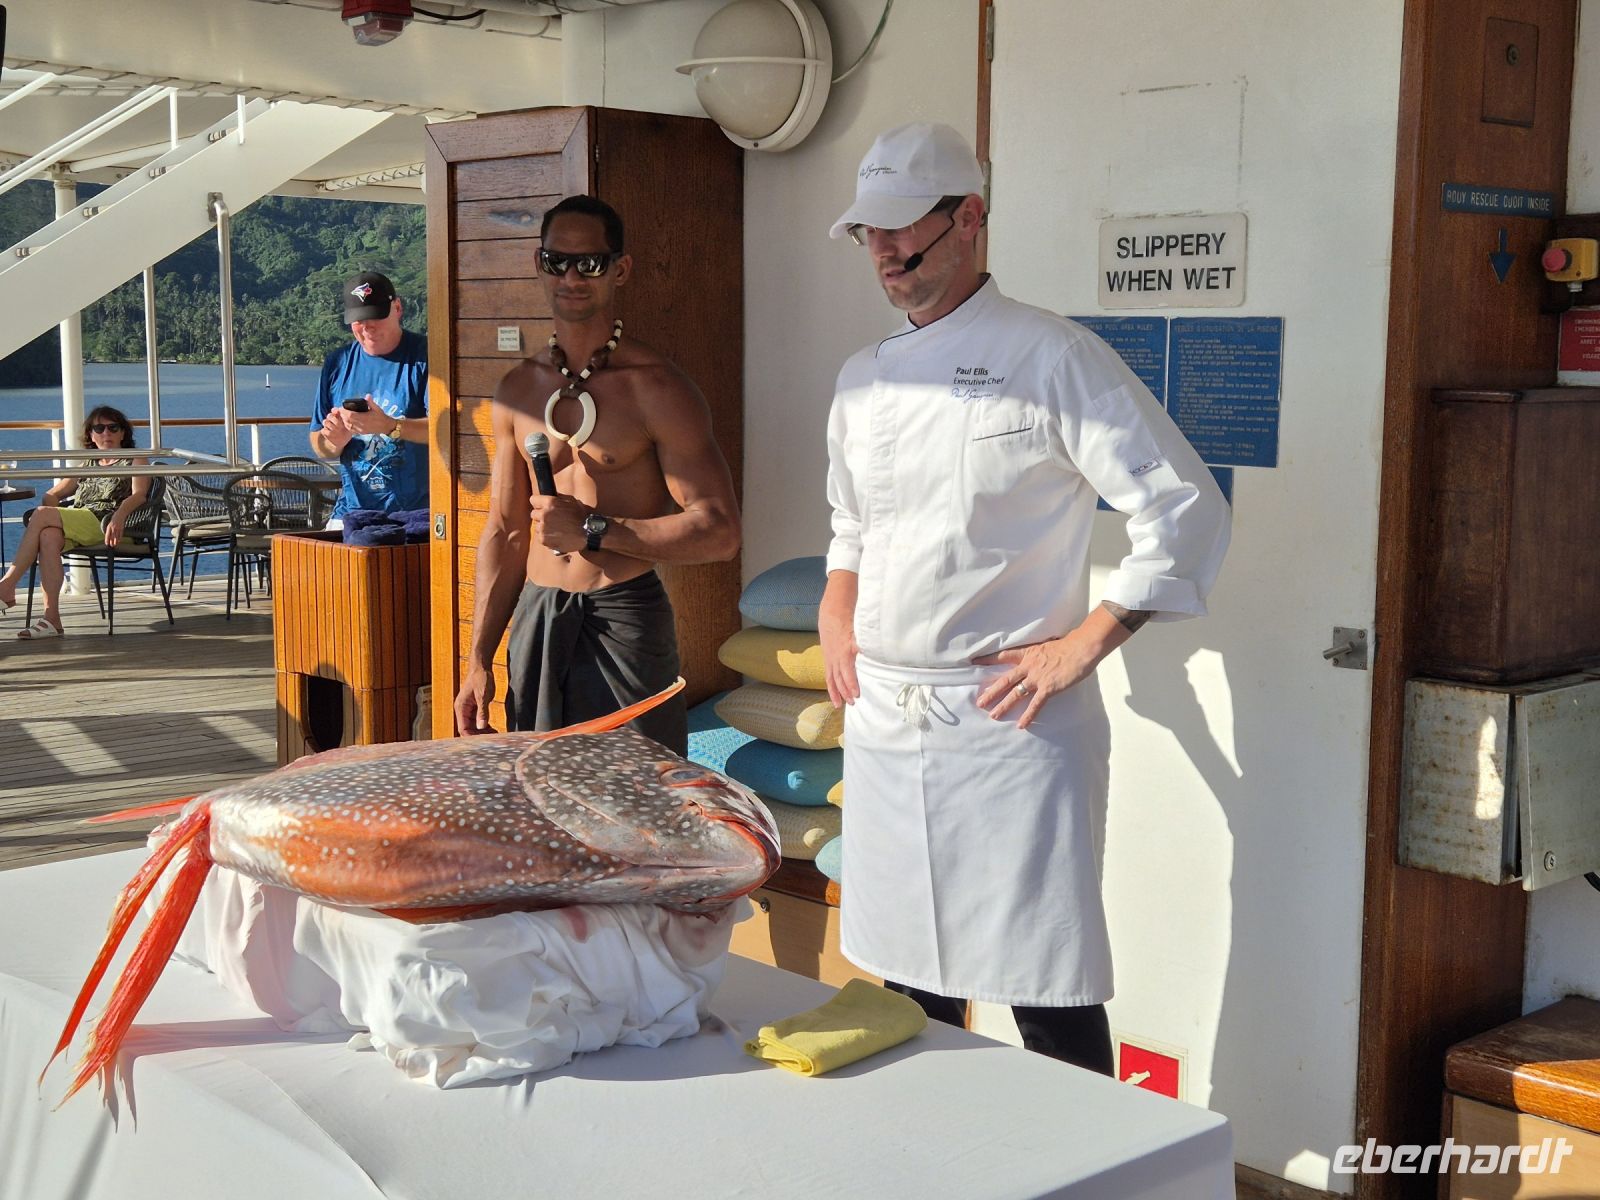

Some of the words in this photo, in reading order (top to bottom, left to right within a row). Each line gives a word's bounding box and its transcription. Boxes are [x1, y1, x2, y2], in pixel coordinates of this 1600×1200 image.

[1471, 192, 1499, 207] RESCUE
[1527, 197, 1550, 212] INSIDE
[1116, 232, 1226, 259] SLIPPERY
[1106, 268, 1173, 292] WHEN
[1183, 267, 1236, 290] WET
[953, 377, 987, 386] Executive
[987, 377, 1005, 385] Chef
[955, 367, 972, 375] Paul
[973, 367, 989, 376] Ellis
